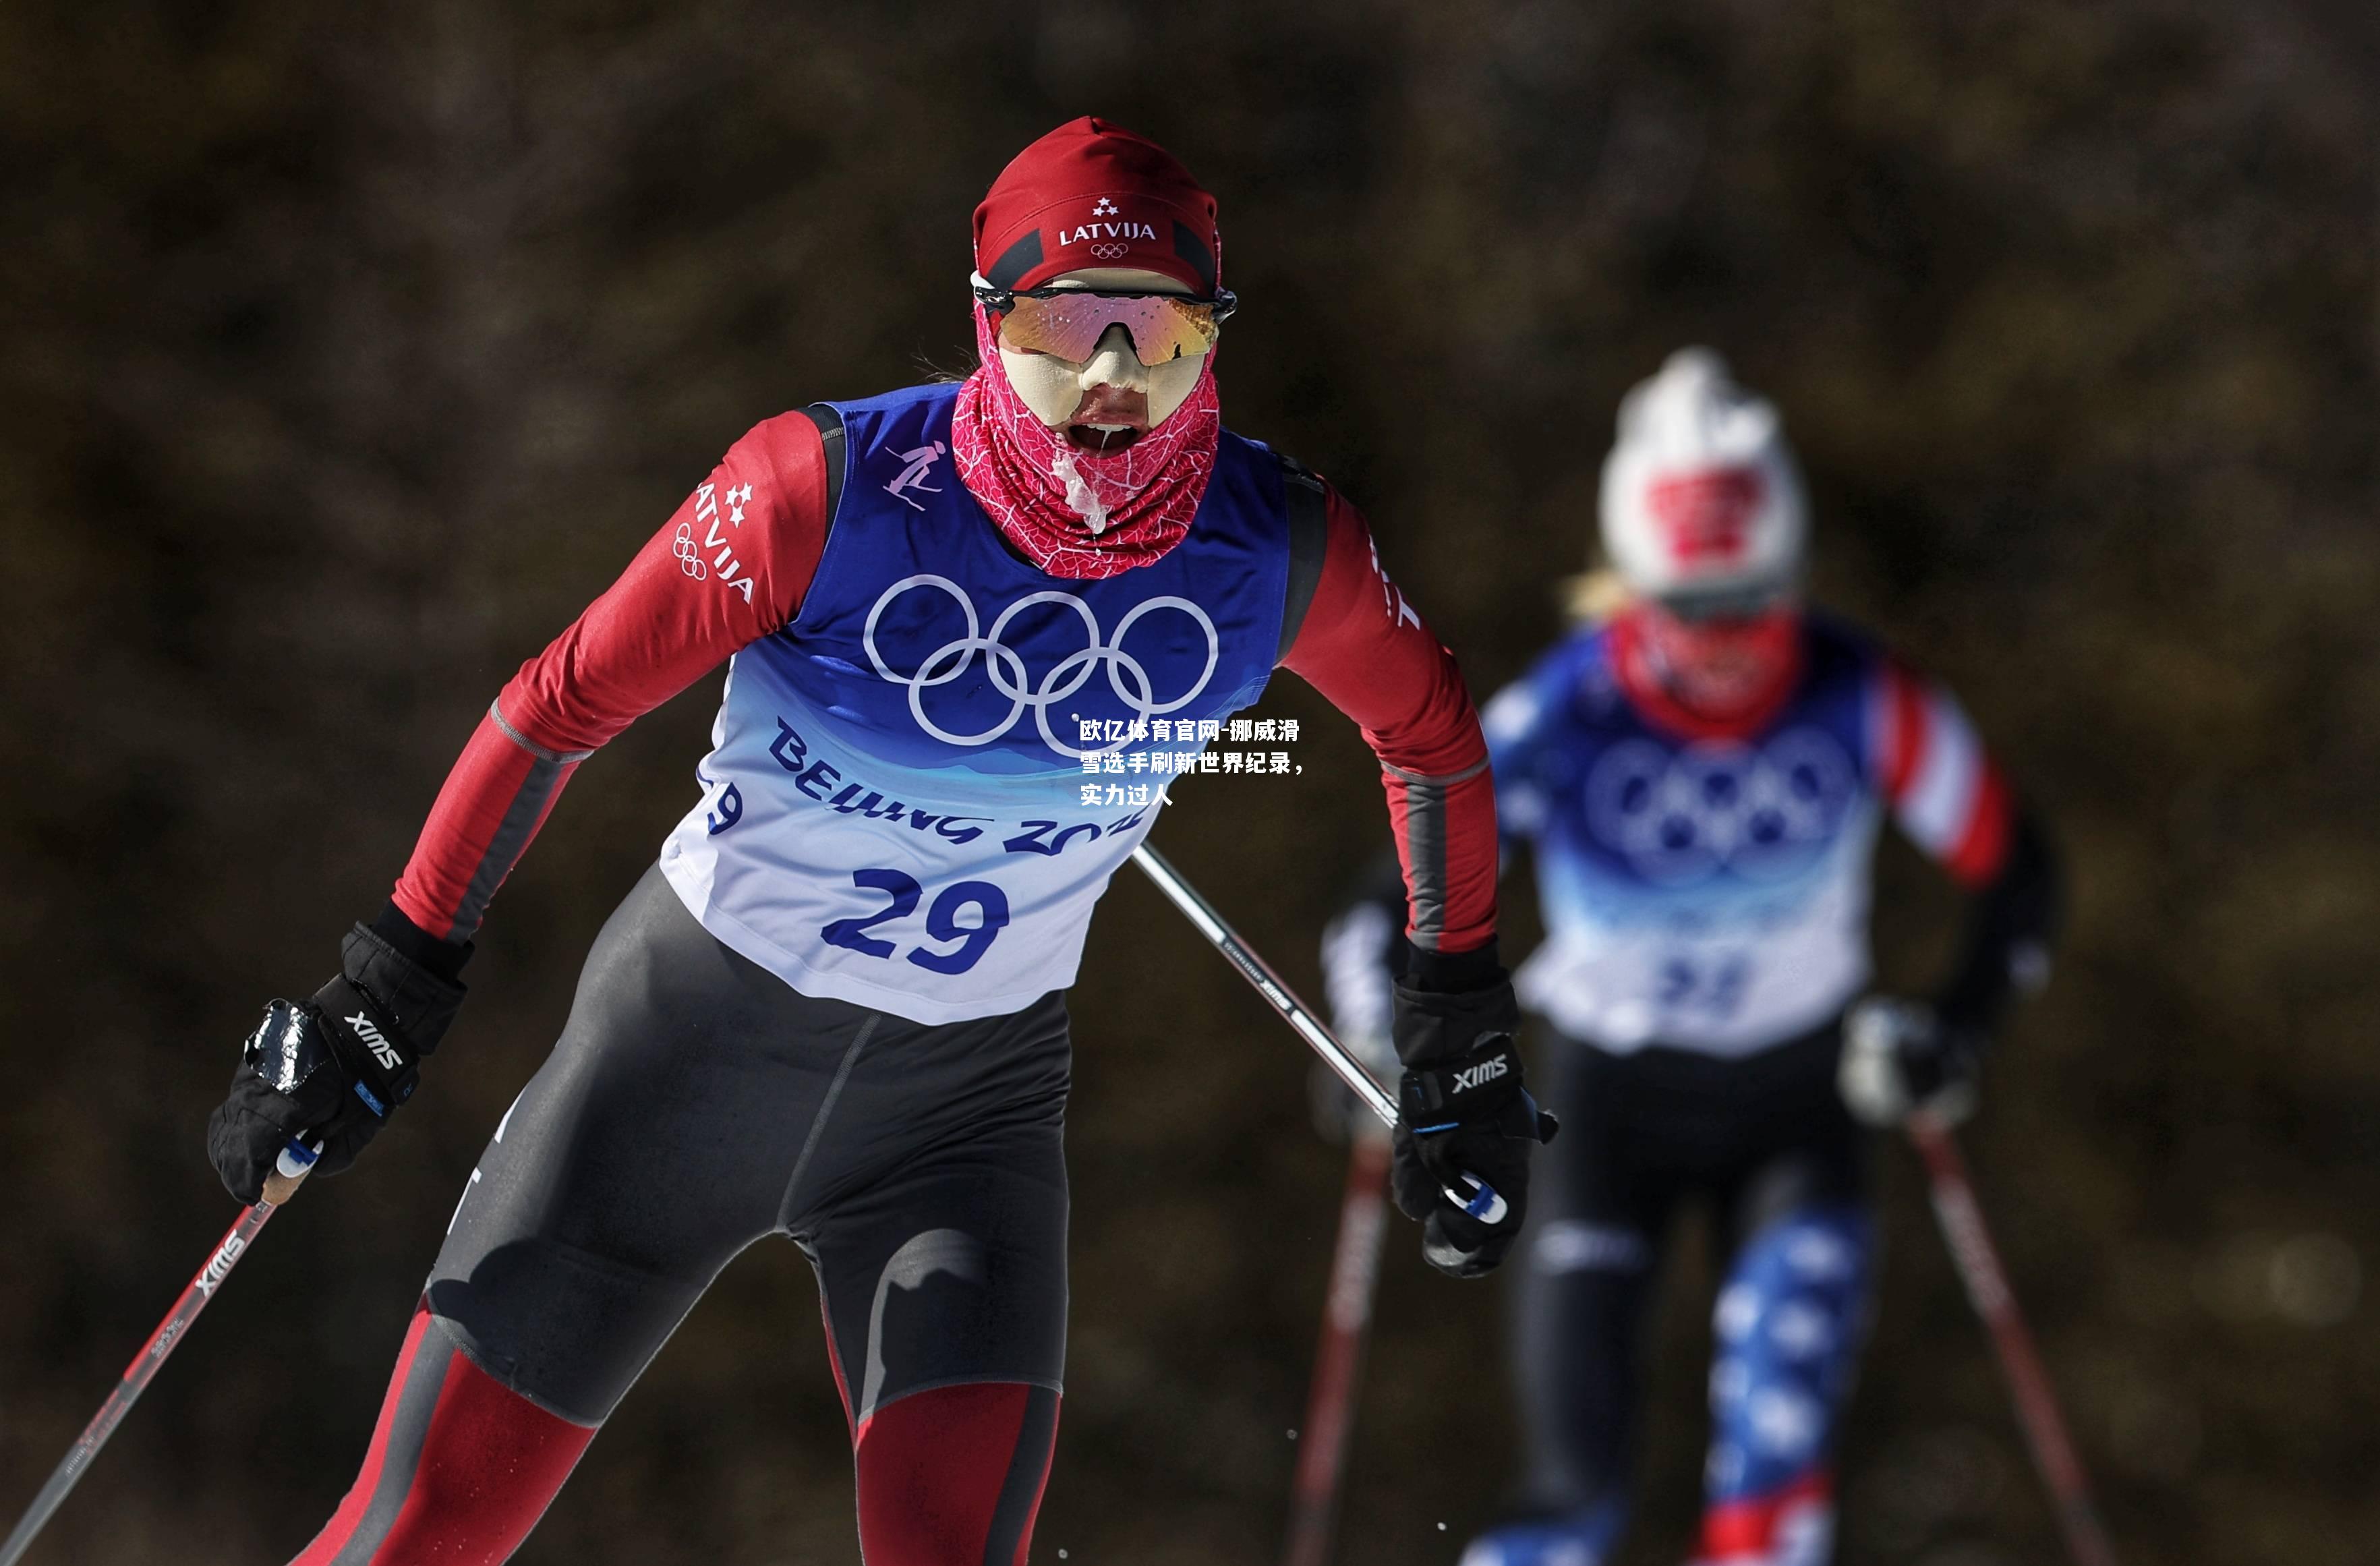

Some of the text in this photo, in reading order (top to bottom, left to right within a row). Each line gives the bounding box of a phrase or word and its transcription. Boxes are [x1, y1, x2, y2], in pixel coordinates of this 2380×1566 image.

[1060, 222, 1156, 246] LATVIJA
[695, 482, 753, 605] ATVIJA
[820, 869, 1010, 975] 29
